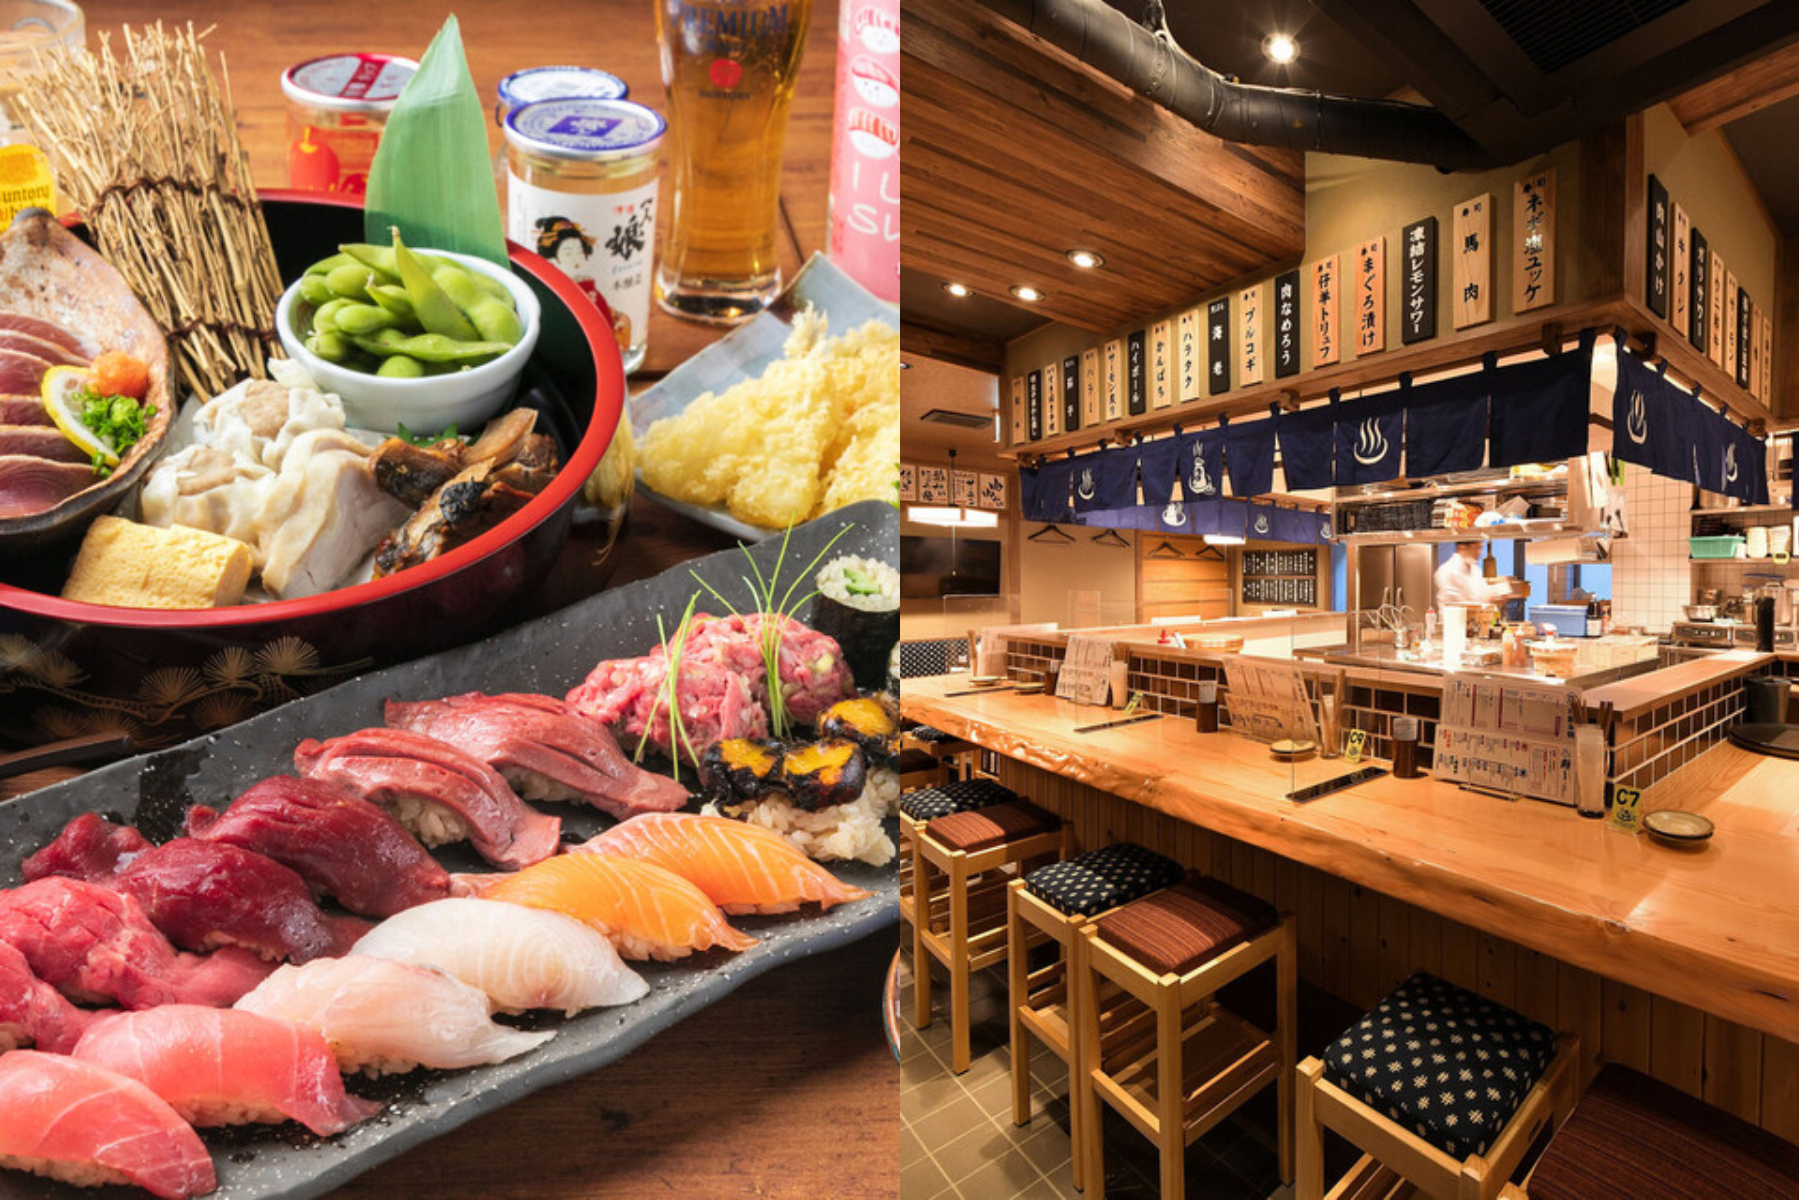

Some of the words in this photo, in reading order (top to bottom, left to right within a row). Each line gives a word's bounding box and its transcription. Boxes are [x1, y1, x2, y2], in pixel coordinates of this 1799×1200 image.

[1463, 233, 1479, 303] 馬肉
[1281, 283, 1292, 366] 肉なめろう
[1318, 273, 1331, 359] 仔羊トリュフ
[1131, 342, 1140, 403] ハイボール
[1617, 788, 1640, 807] C7
